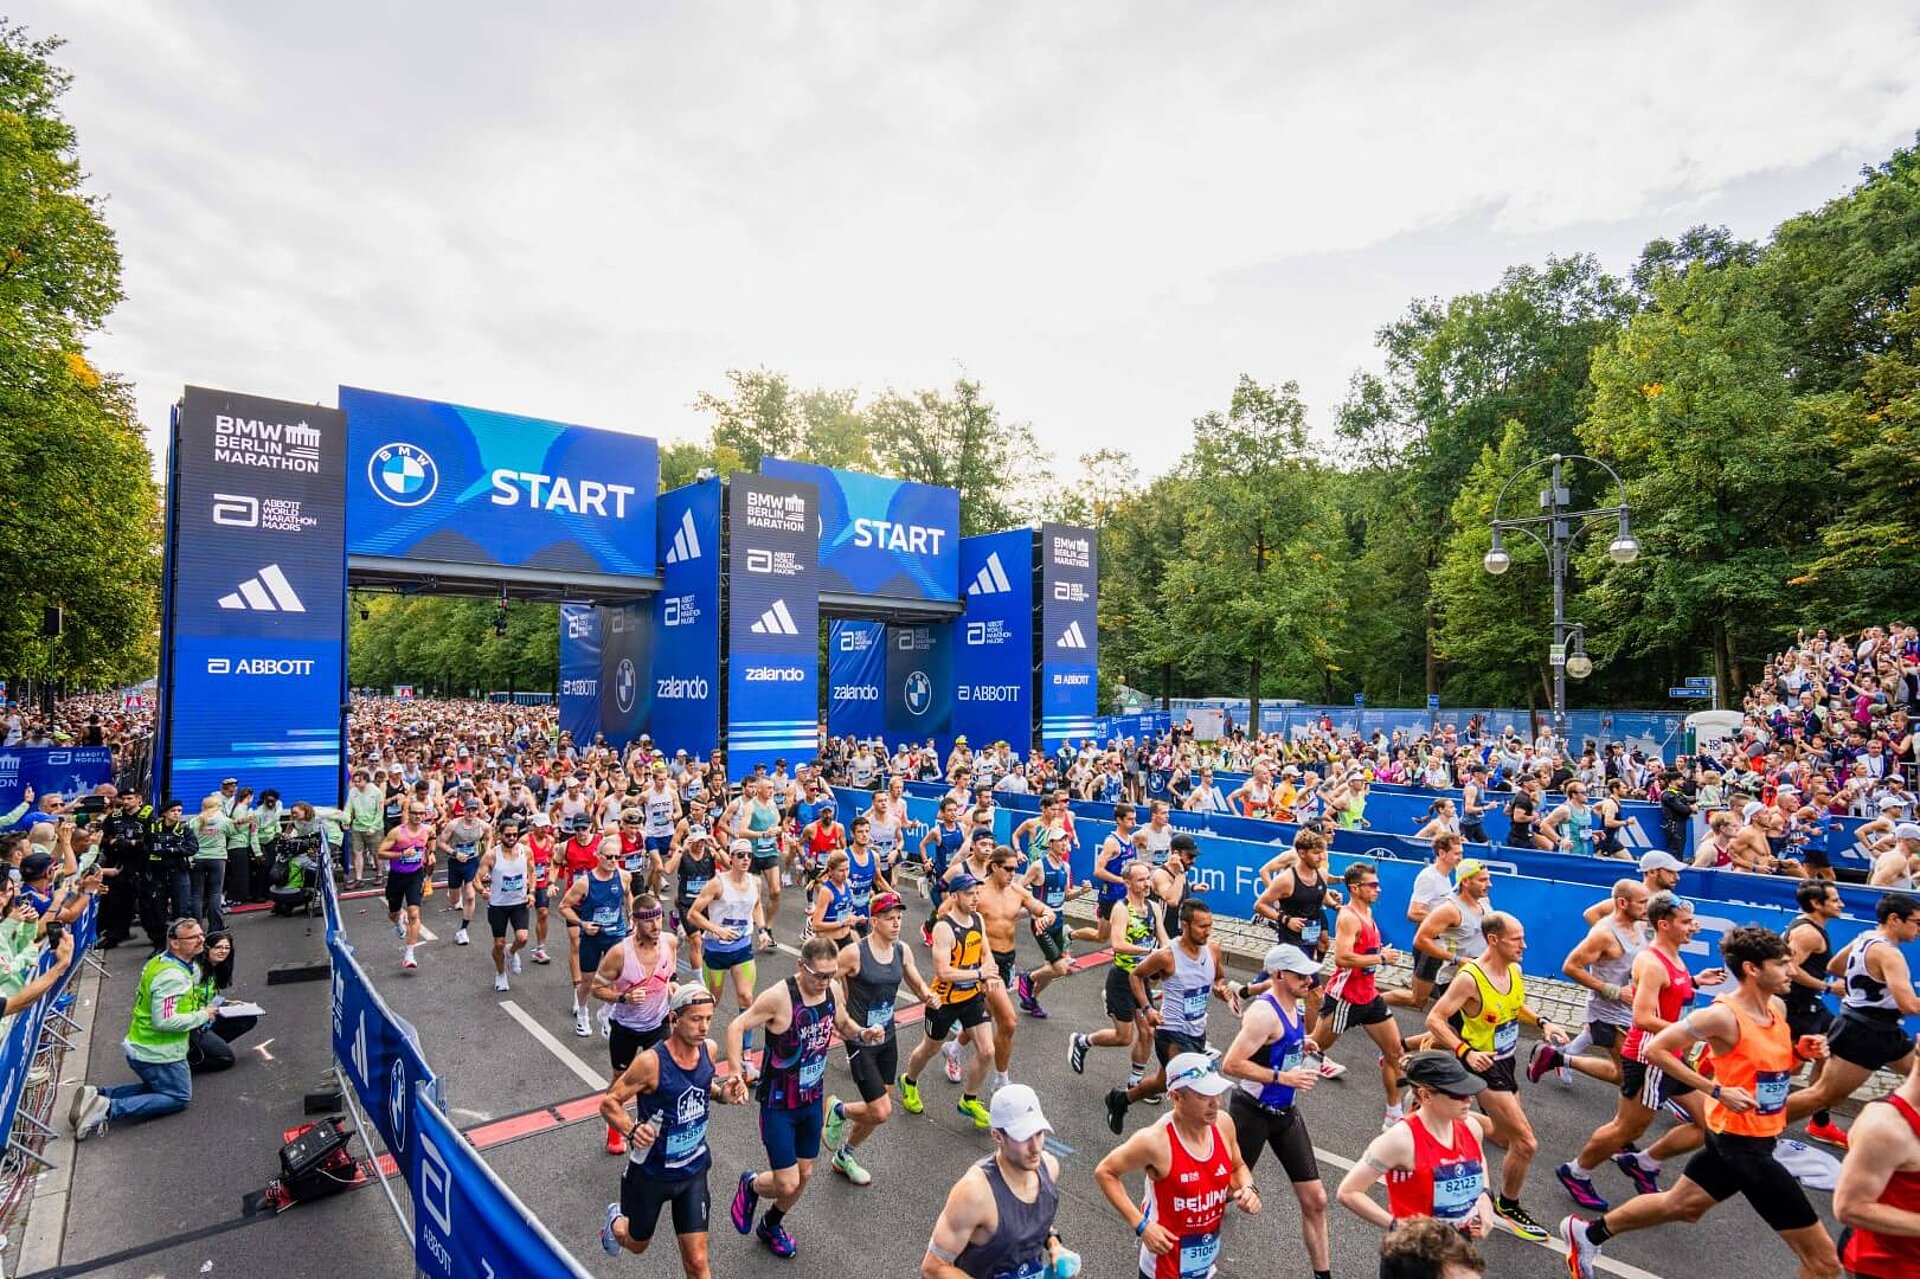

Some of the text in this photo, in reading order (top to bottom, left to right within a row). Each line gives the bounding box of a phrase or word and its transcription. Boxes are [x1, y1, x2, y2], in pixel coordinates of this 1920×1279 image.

[216, 415, 282, 441] BMW
[215, 434, 282, 455] BERLIN
[215, 448, 319, 474] MARATHON
[490, 468, 635, 518] START
[747, 491, 784, 510] BMW
[262, 498, 301, 510] ABBOTT
[262, 507, 299, 517] WORLD
[262, 515, 317, 527] MARATHON
[747, 506, 784, 520] BERLIN
[262, 521, 301, 532] MAJORS
[747, 516, 804, 532] MARATHON
[854, 518, 945, 555] START
[1054, 537, 1077, 551] BMW
[235, 659, 314, 675] ABBOTT
[746, 668, 804, 681] zalando
[571, 680, 597, 696] ABBOTT
[657, 675, 708, 699] zalando
[833, 684, 878, 700] zalando
[973, 686, 1020, 701] ABBOTT
[1446, 1176, 1476, 1193] 82123
[423, 1224, 451, 1276] ABBOTT
